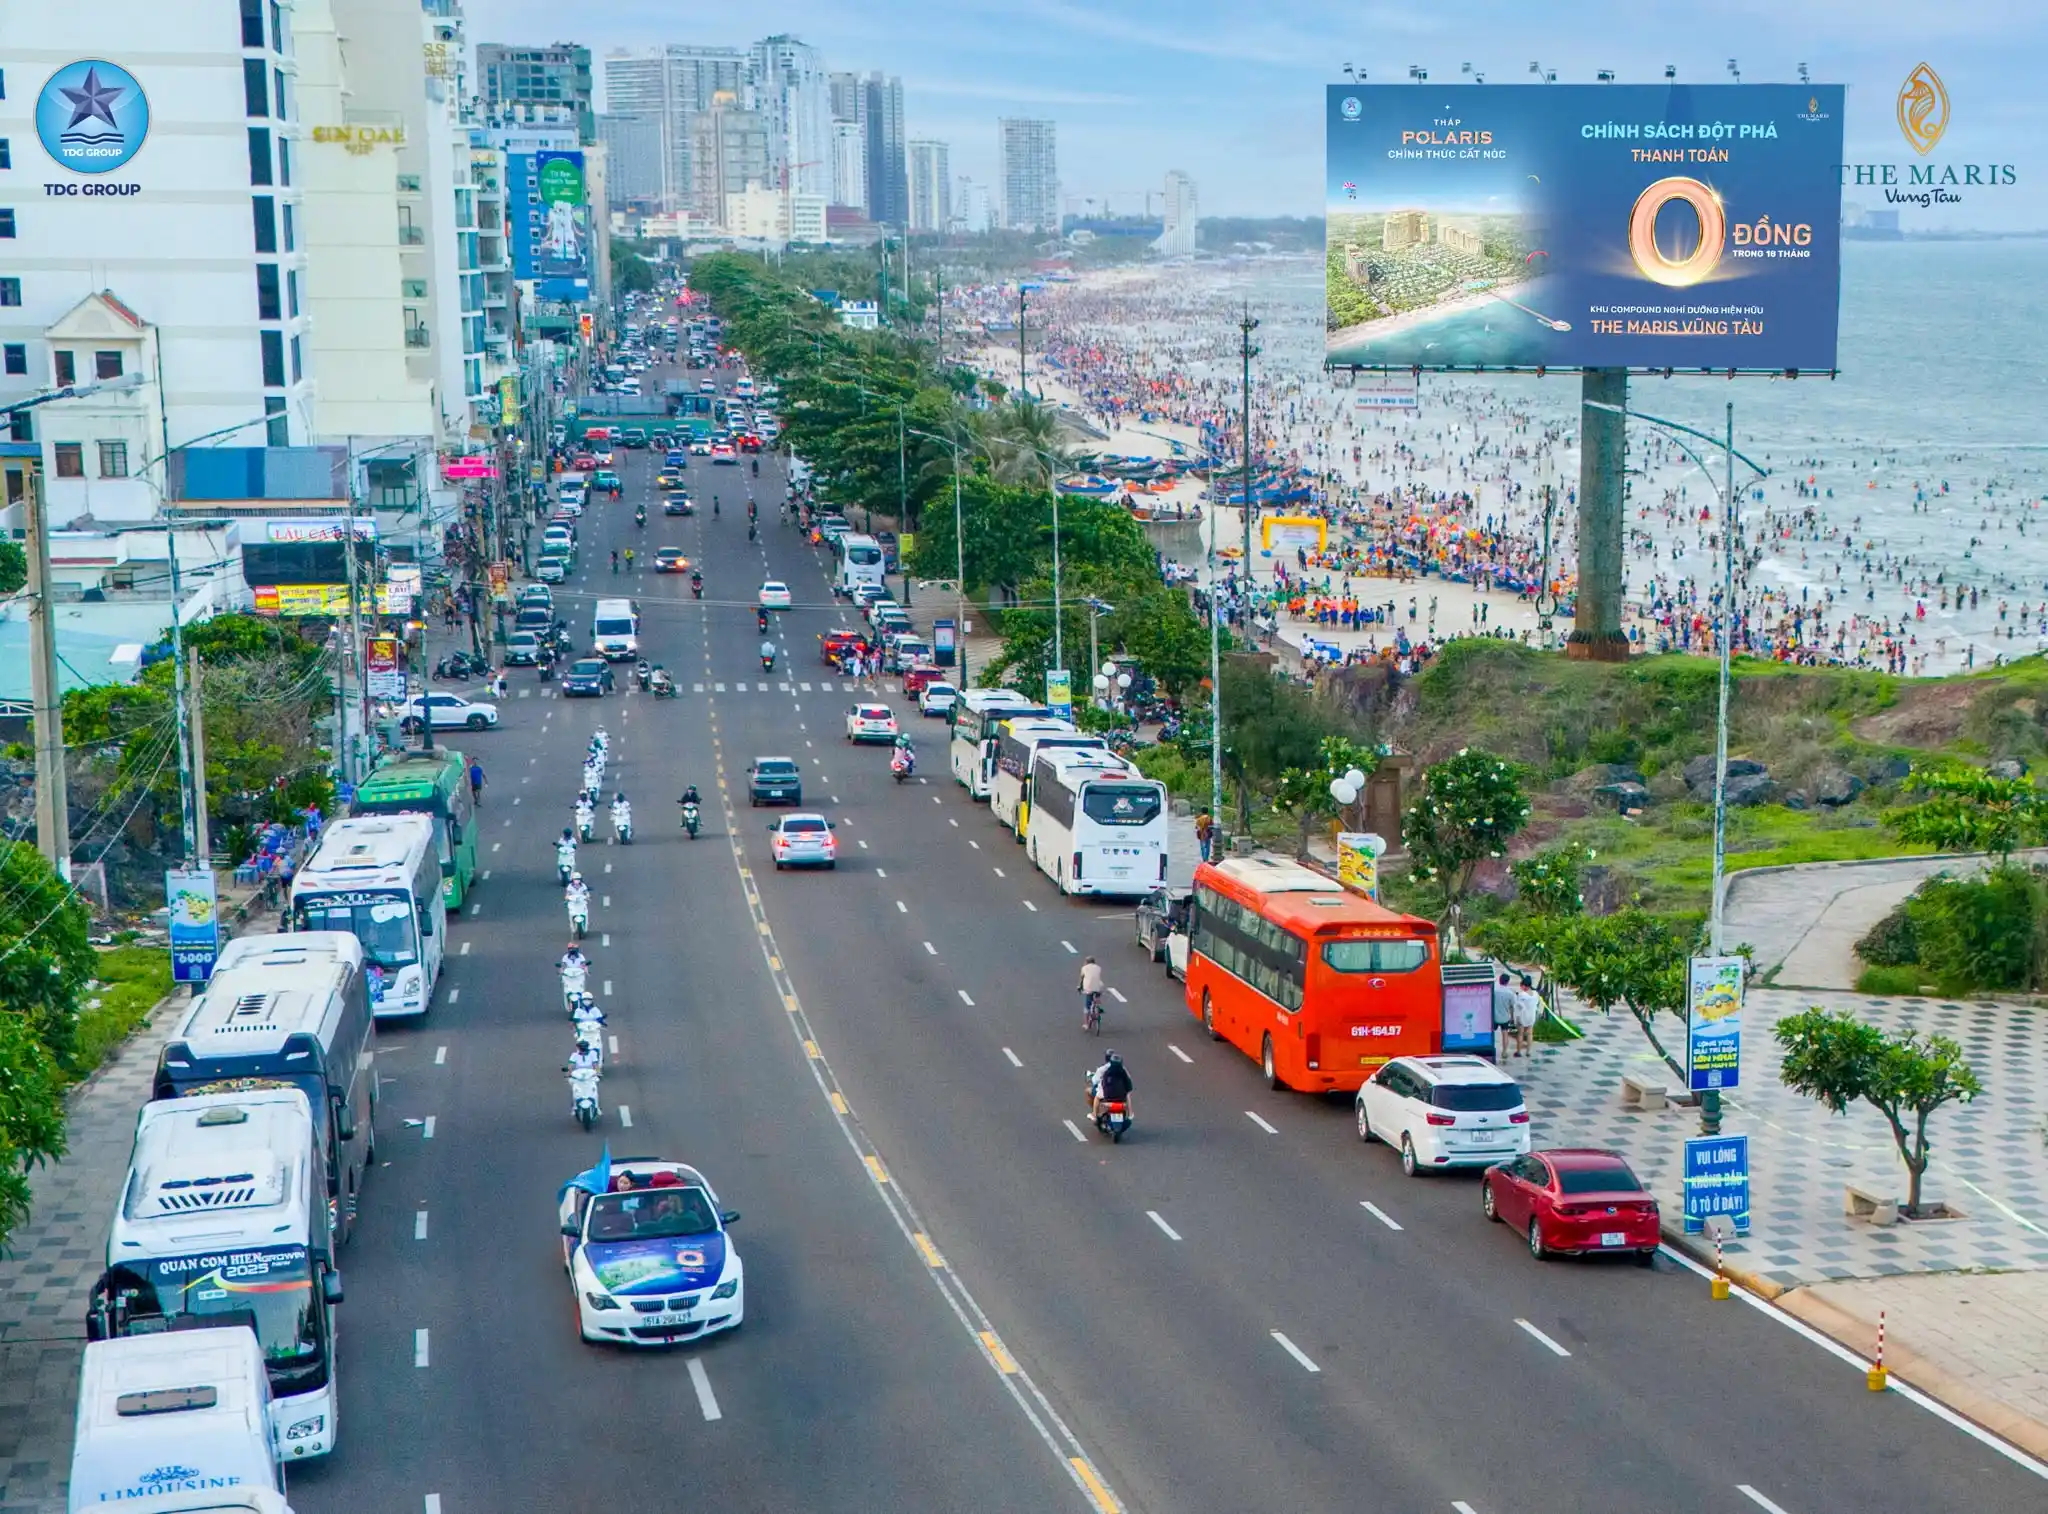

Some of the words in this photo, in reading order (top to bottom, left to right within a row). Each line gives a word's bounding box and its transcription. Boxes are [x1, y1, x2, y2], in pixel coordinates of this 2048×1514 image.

[1434, 117, 1461, 126] THÁP
[1402, 130, 1493, 145] POLARIS
[1580, 121, 1640, 139] CHÍNH
[1644, 121, 1694, 139] SÁCH
[1698, 121, 1736, 142] ĐỘT
[1739, 121, 1778, 139] PHÁ
[1388, 148, 1423, 159] CHÍNH
[1426, 148, 1456, 159] THỨC
[1460, 146, 1480, 159] CẤT
[1631, 148, 1684, 163] THANH
[1688, 146, 1729, 163] TOÁN
[1732, 214, 1812, 246] ĐỒNG
[1732, 250, 1764, 258] TRONG
[1766, 250, 1776, 258] 18
[1778, 248, 1811, 258] THÁNG
[1590, 305, 1608, 314] KHU
[1610, 305, 1662, 314] COMPOUND
[1688, 304, 1719, 314] DƯỠNG
[1720, 304, 1742, 315] HIỆN
[1744, 304, 1764, 314] HỮU
[1590, 320, 1624, 334] THE
[1627, 320, 1678, 334] MARIS
[1682, 318, 1728, 335] VŨNG
[1732, 318, 1764, 335] TÀU
[1696, 1150, 1710, 1165] VUI
[1713, 1147, 1736, 1164] LÒNG
[1690, 1196, 1698, 1214] Ô
[1700, 1196, 1711, 1212] TÔ
[160, 1258, 198, 1275] QUAN
[200, 1255, 228, 1268] COM
[230, 1252, 264, 1265] HIEN
[226, 1262, 269, 1277] 2025
